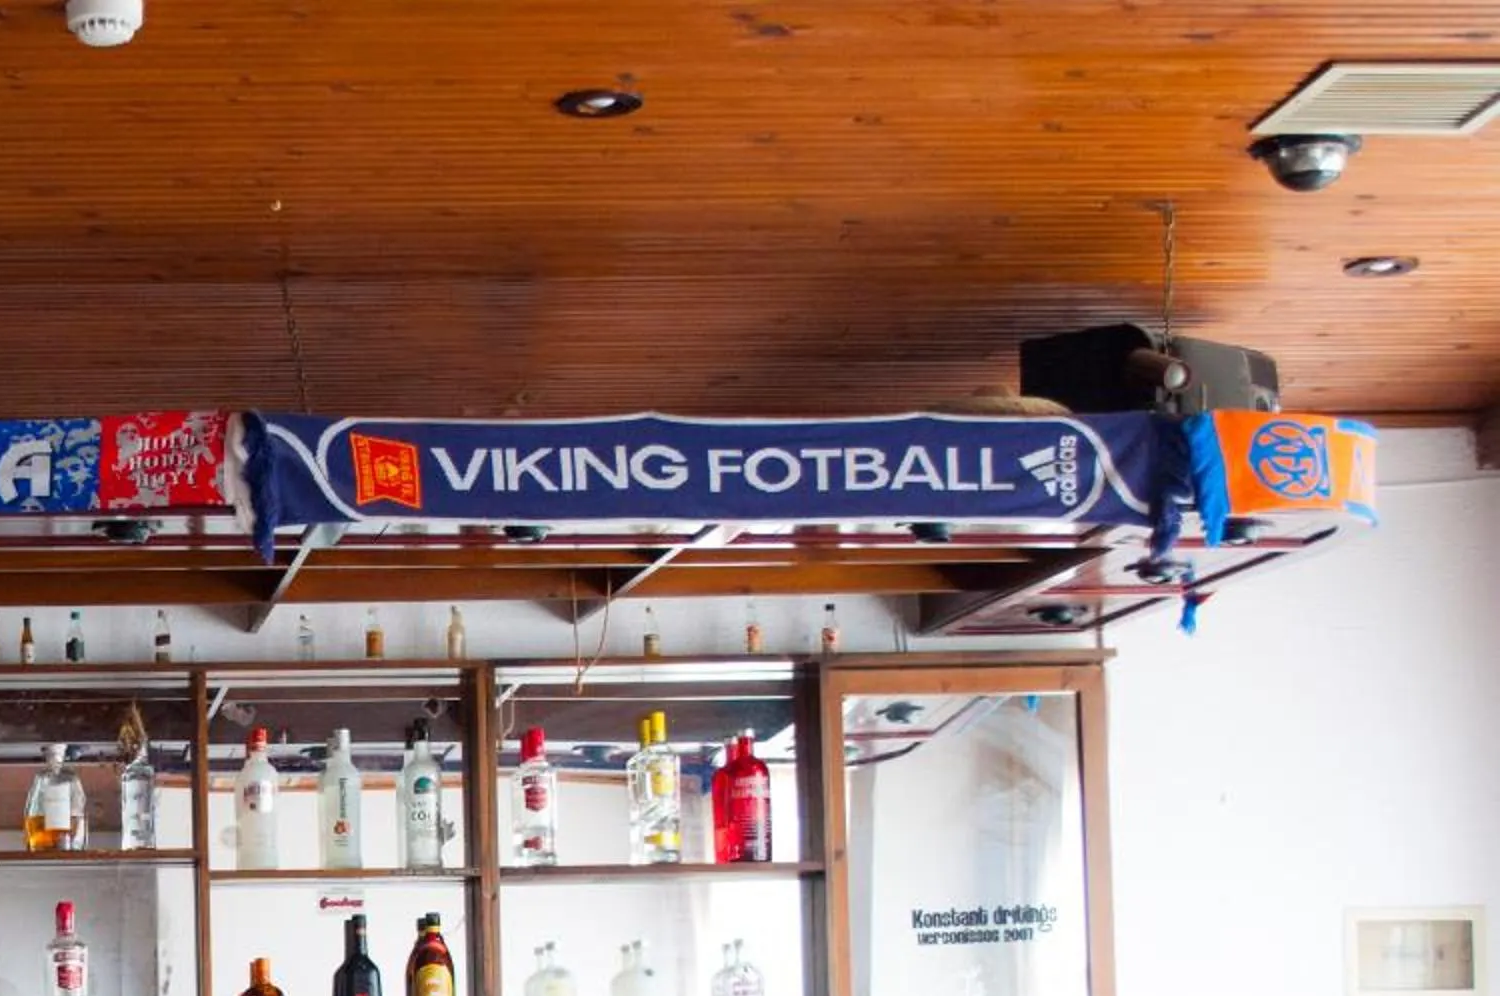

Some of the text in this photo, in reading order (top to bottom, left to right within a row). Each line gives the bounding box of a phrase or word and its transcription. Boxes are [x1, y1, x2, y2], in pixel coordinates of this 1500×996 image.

[430, 444, 688, 492] VIKING
[707, 445, 1016, 492] FOTBALL
[1055, 435, 1078, 506] adidas
